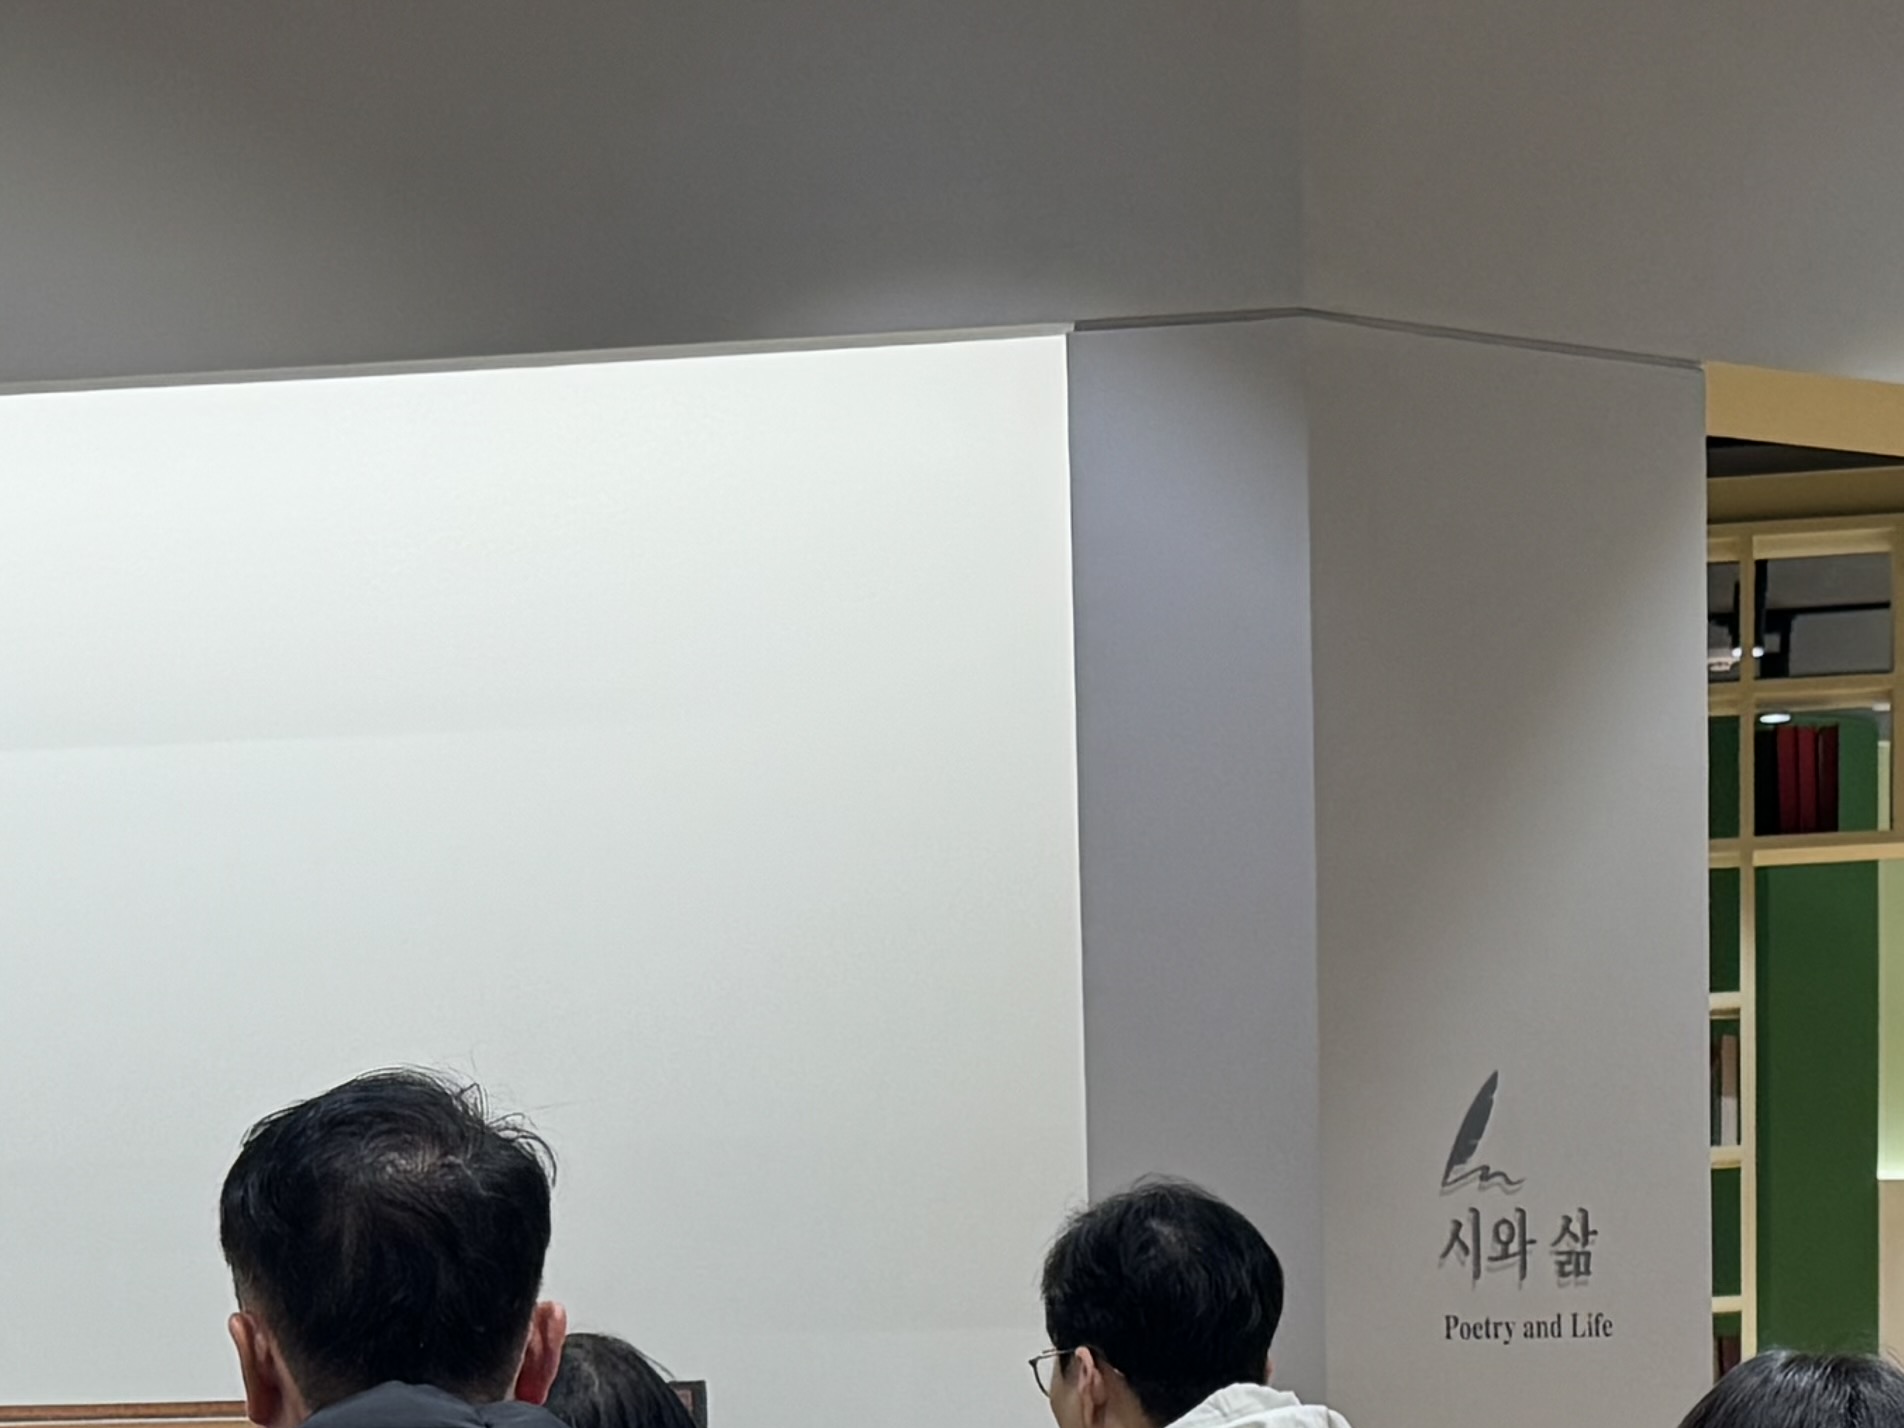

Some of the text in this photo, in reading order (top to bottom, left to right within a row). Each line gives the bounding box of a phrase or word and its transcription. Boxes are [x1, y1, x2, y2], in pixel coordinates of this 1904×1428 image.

[1440, 1206, 1599, 1281] 시와 삶
[1444, 1312, 1614, 1345] Poetry and Life
